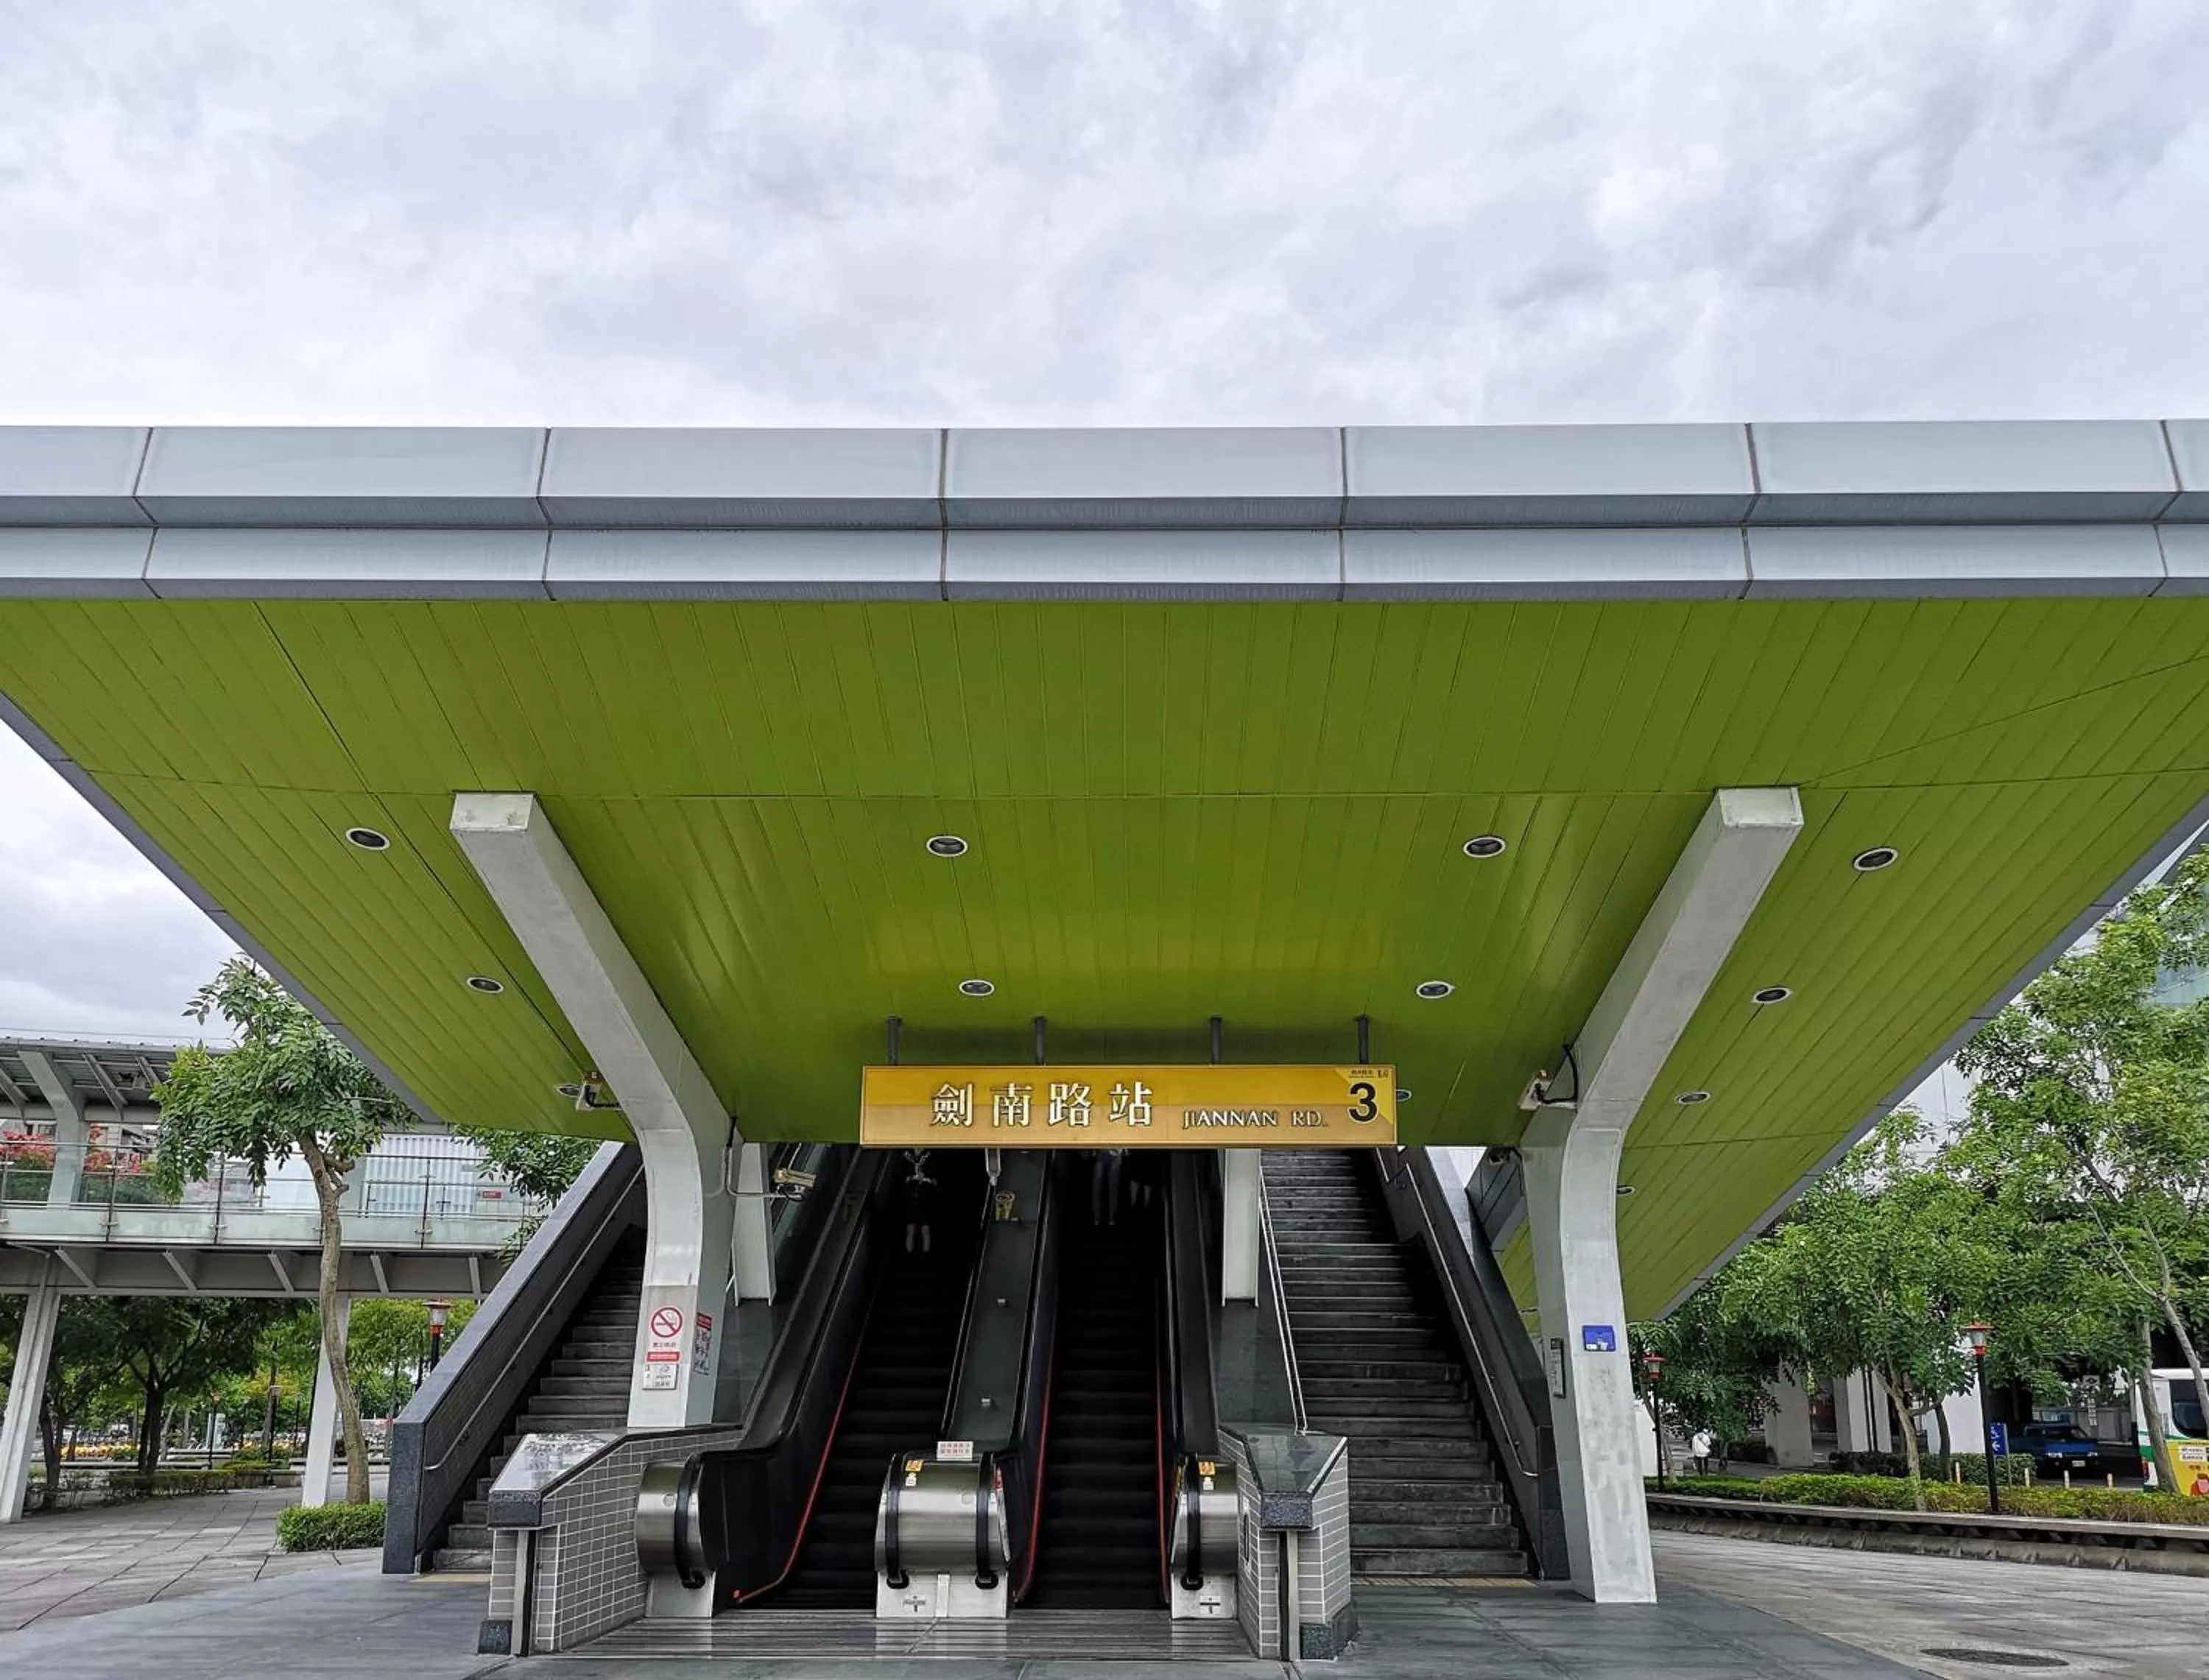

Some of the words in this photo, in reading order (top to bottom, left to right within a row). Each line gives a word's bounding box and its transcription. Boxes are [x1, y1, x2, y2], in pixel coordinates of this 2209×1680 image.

[929, 1081, 1153, 1127] 劍南路站
[1183, 1109, 1278, 1129] JIANNAN
[1292, 1109, 1328, 1127] RD.
[1348, 1081, 1378, 1123] 3
